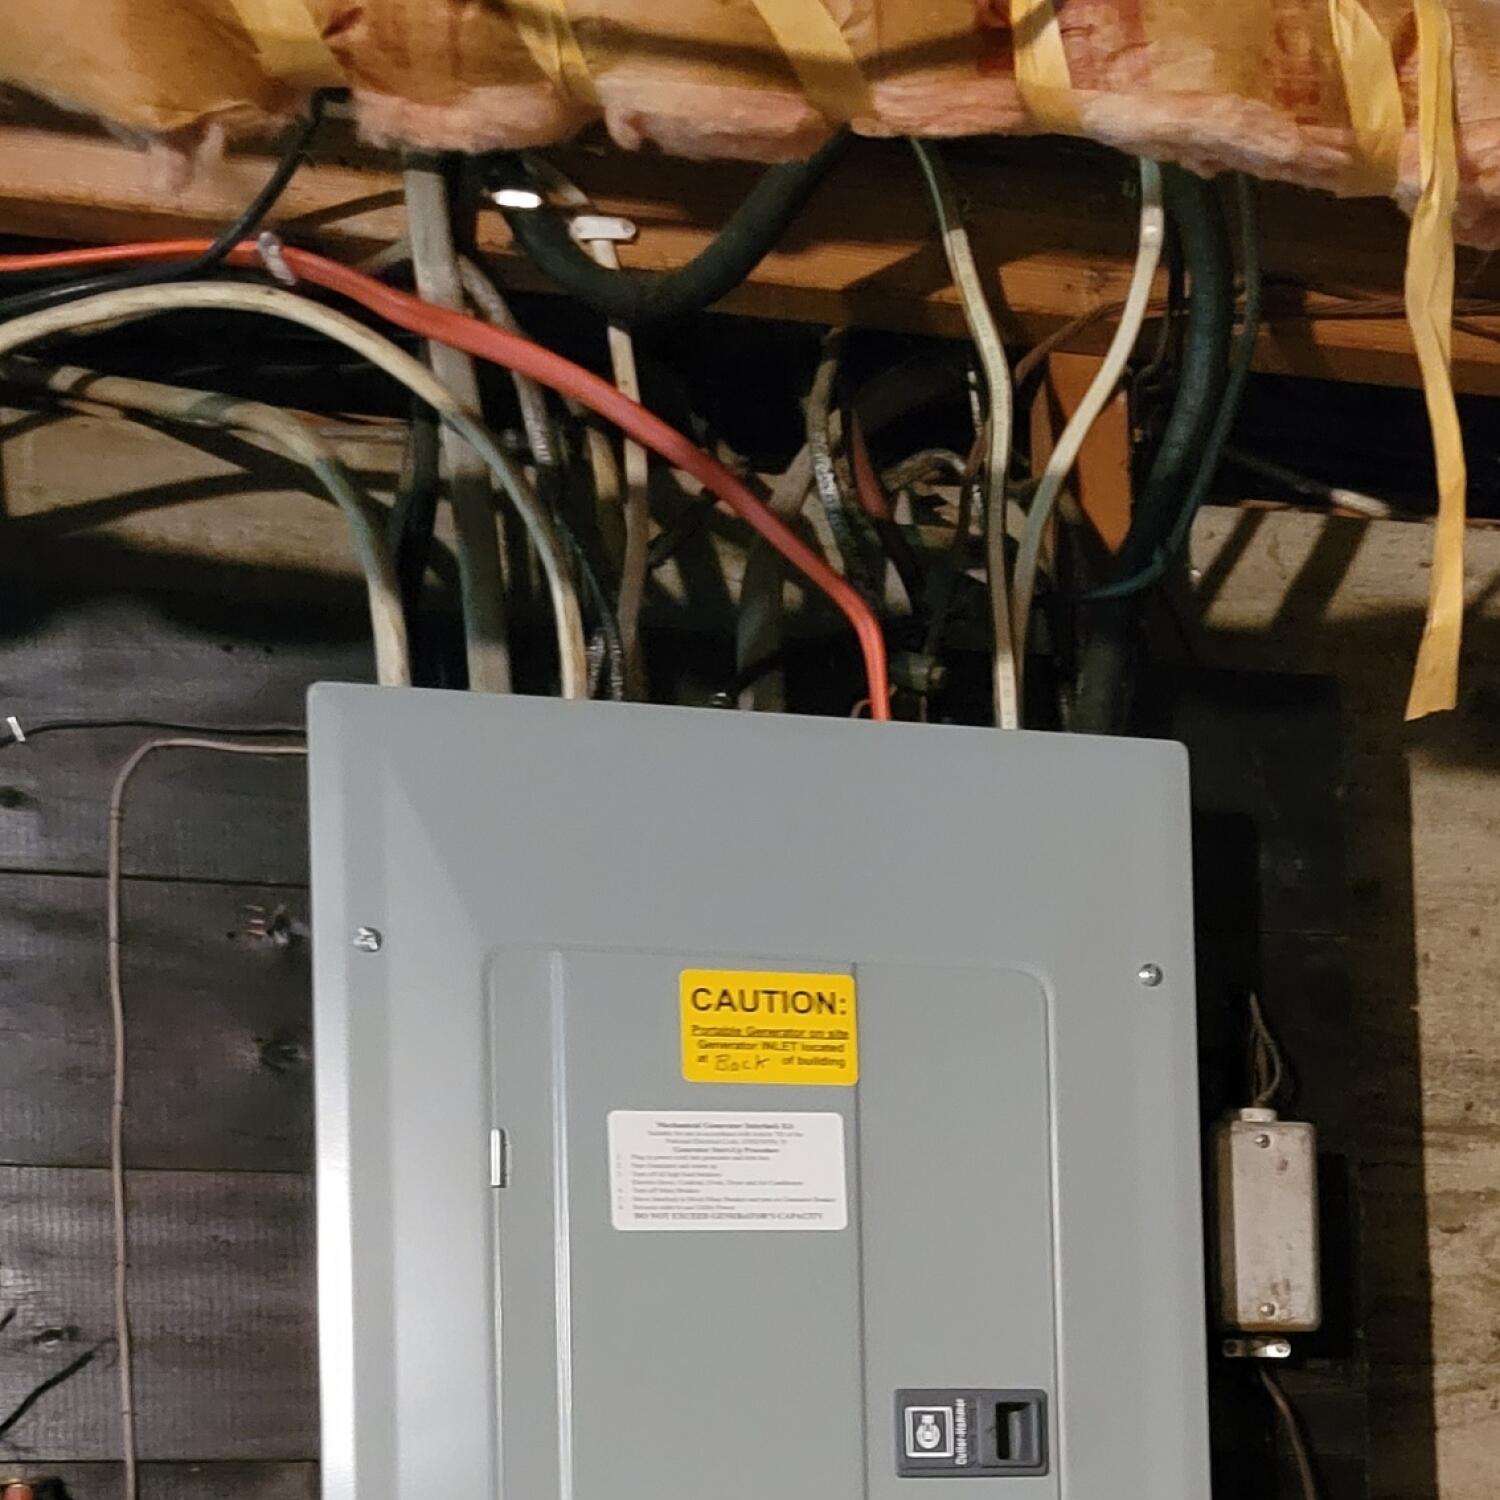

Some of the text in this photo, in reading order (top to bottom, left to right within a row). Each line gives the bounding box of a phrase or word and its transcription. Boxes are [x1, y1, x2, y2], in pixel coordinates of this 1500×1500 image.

[691, 988, 847, 1015] CAUTION:
[745, 1026, 805, 1038] Generator
[698, 1039, 758, 1050] Generator
[762, 1041, 797, 1051] INLET
[797, 1056, 847, 1069] building
